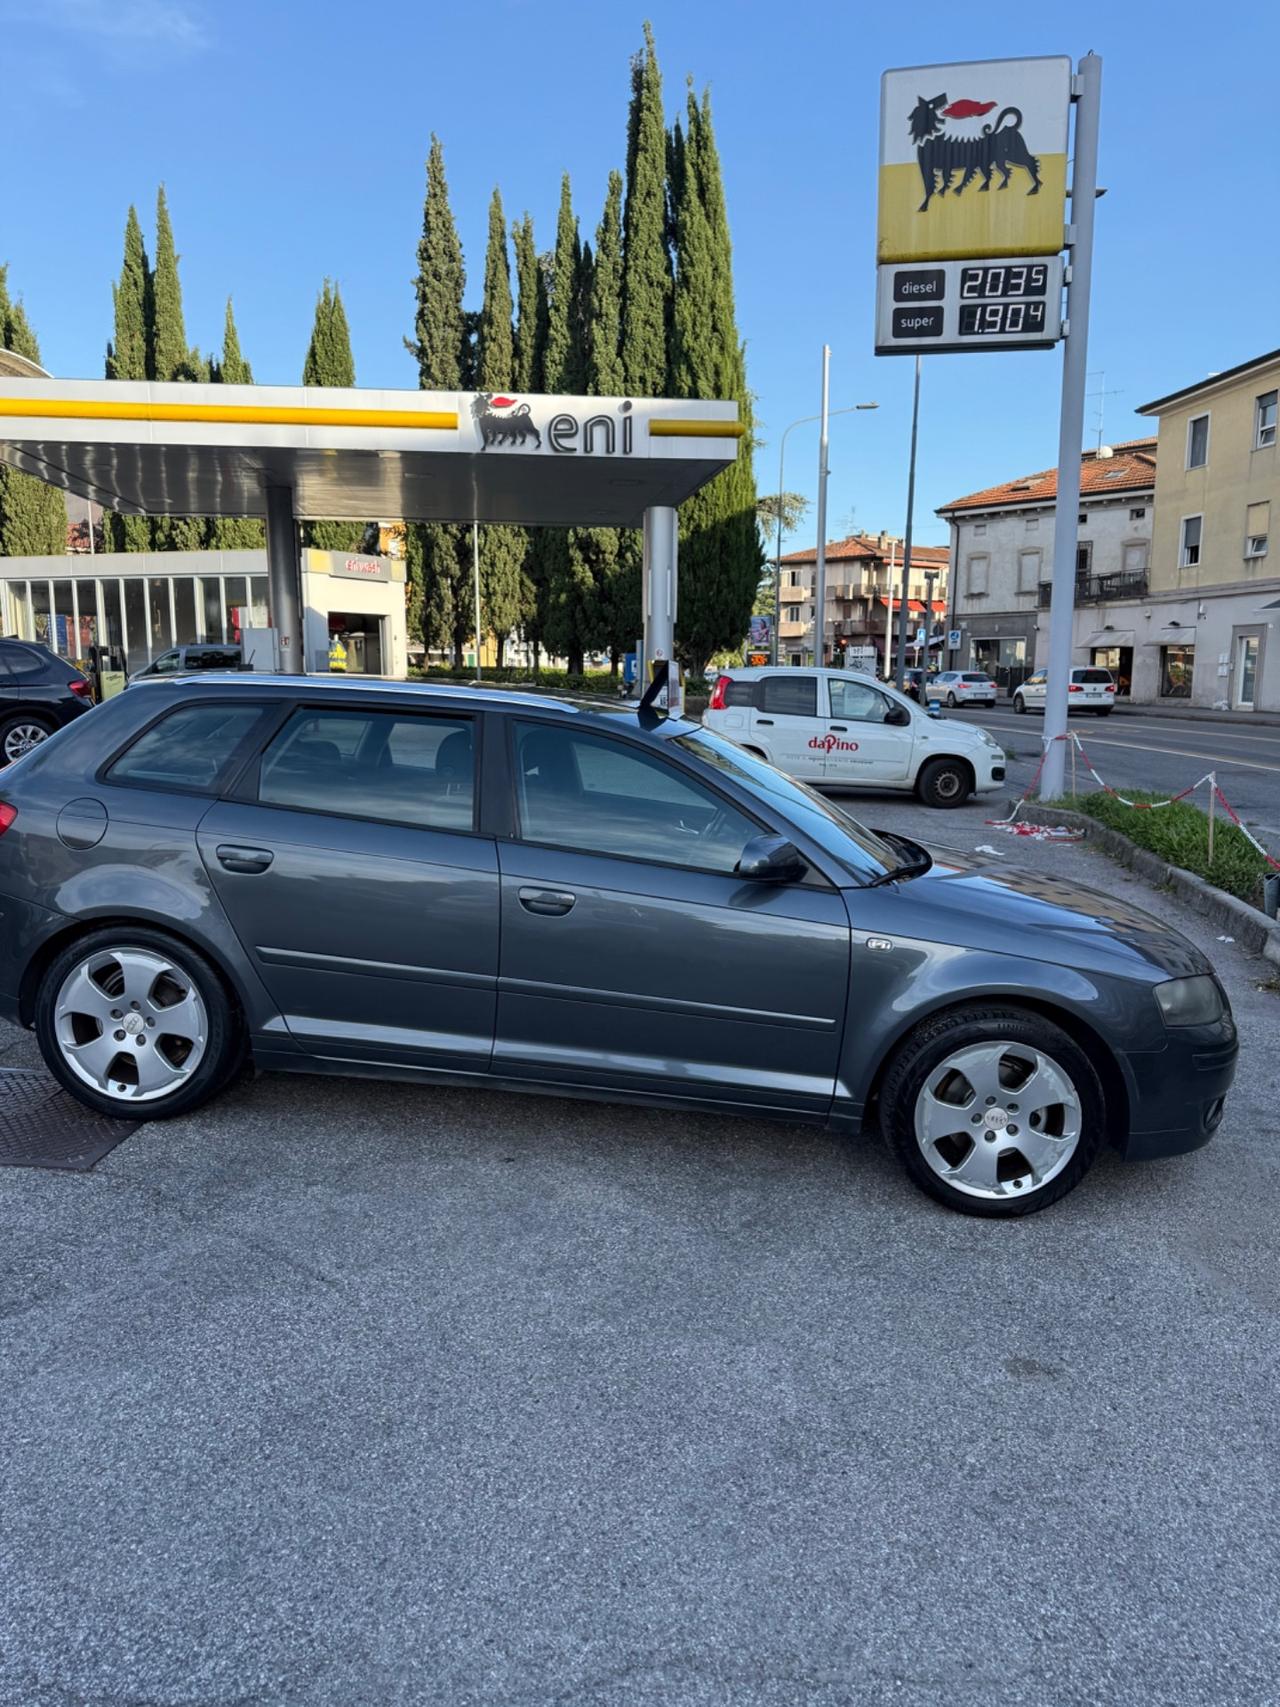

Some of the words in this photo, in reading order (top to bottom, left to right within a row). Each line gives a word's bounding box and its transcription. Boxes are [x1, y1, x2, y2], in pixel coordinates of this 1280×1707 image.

[901, 280, 937, 294] diesel
[900, 316, 935, 330] super
[548, 400, 633, 454] eni
